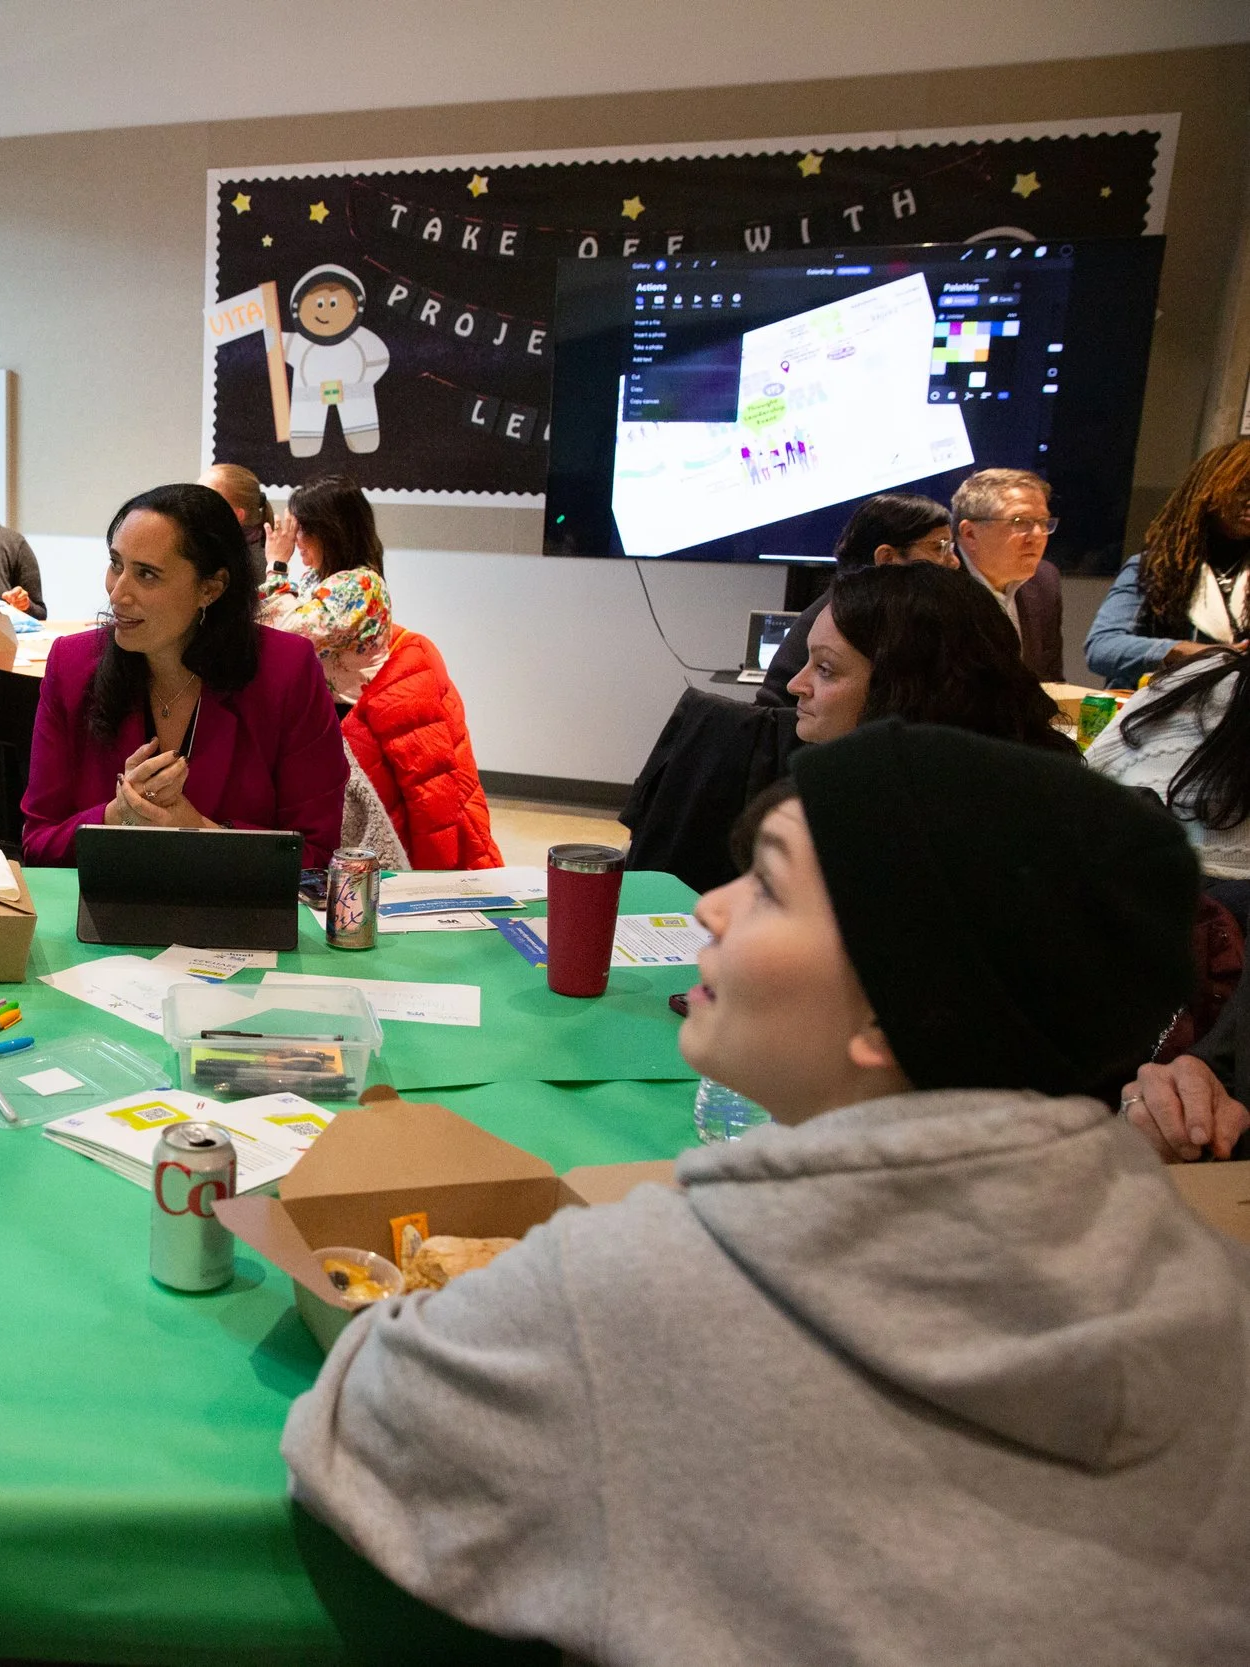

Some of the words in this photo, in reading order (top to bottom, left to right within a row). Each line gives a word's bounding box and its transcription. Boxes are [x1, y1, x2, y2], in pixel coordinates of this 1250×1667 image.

[390, 204, 517, 256] TAKE
[579, 235, 684, 258] OFF
[744, 188, 917, 252] WITH
[636, 283, 668, 292] Actions
[943, 283, 980, 292] Palettes
[208, 301, 264, 337] VITA
[387, 284, 547, 356] PROJE
[471, 399, 549, 440] LE
[336, 877, 358, 909] La
